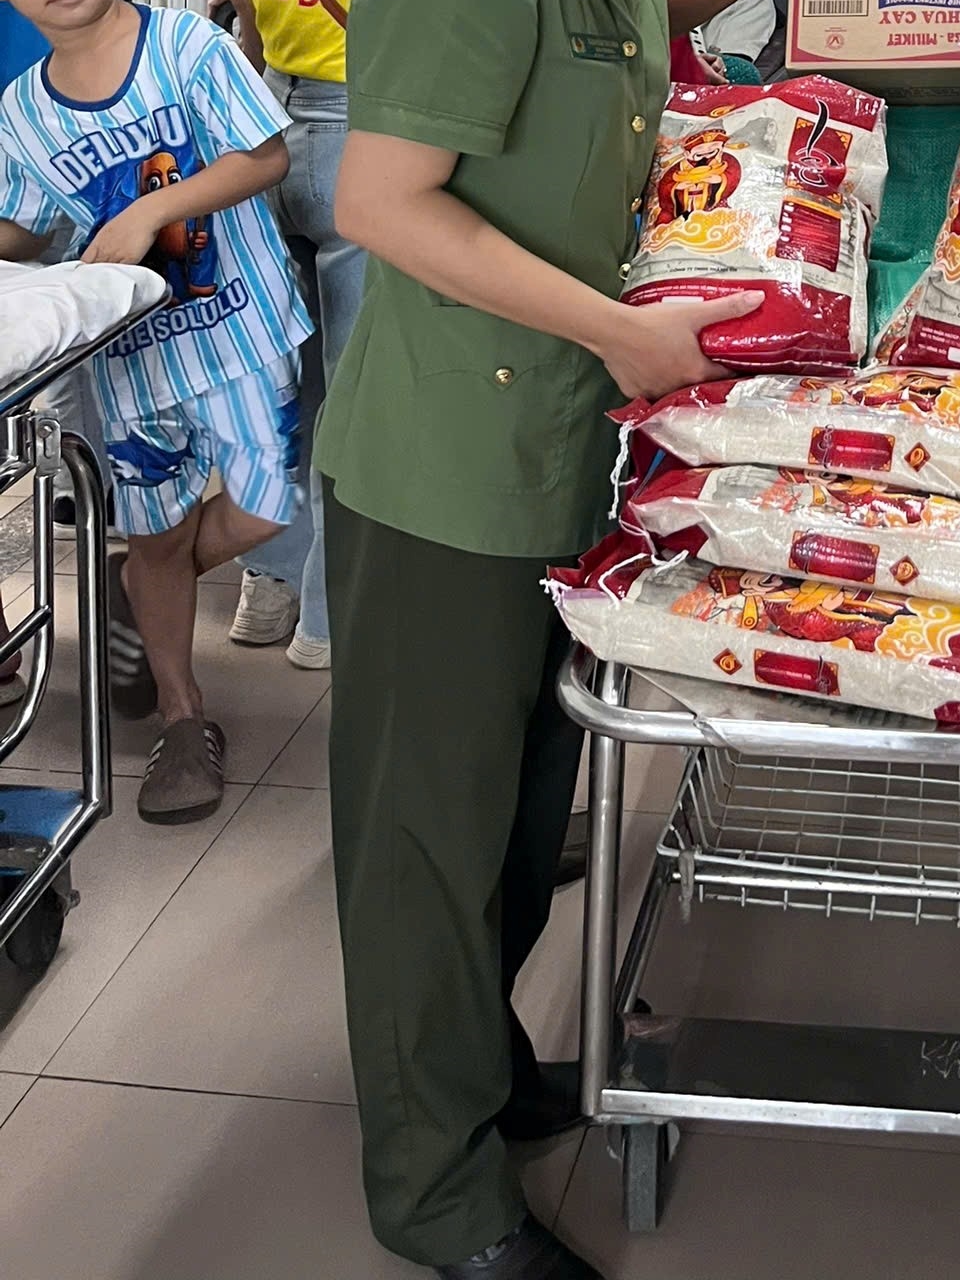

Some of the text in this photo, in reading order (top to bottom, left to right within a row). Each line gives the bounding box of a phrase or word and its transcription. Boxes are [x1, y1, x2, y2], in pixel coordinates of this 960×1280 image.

[879, 11, 917, 25] CAY
[887, 32, 938, 47] MILIKET
[153, 278, 250, 342] SOLULU
